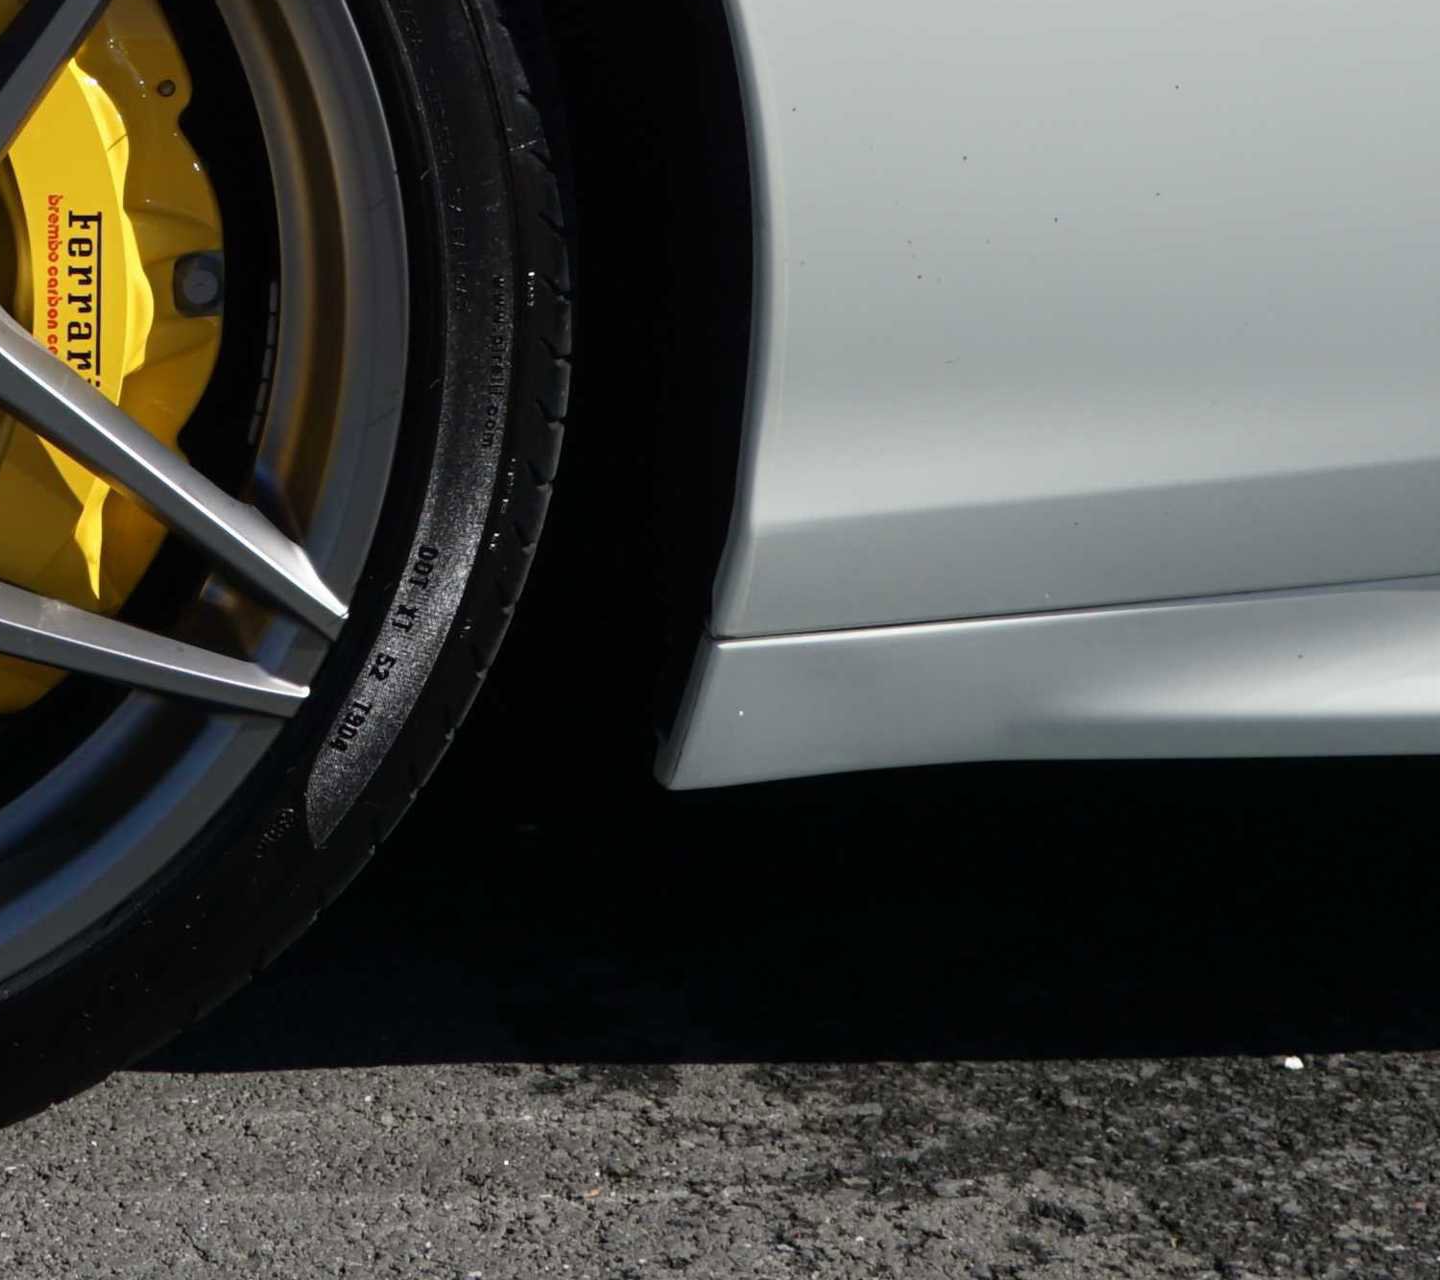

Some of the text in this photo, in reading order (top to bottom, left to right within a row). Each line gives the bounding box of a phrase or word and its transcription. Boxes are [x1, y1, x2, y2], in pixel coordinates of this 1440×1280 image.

[47, 194, 63, 262] brembo
[47, 266, 62, 329] carbon
[67, 209, 102, 388] Ferrar
[367, 647, 398, 682] 52
